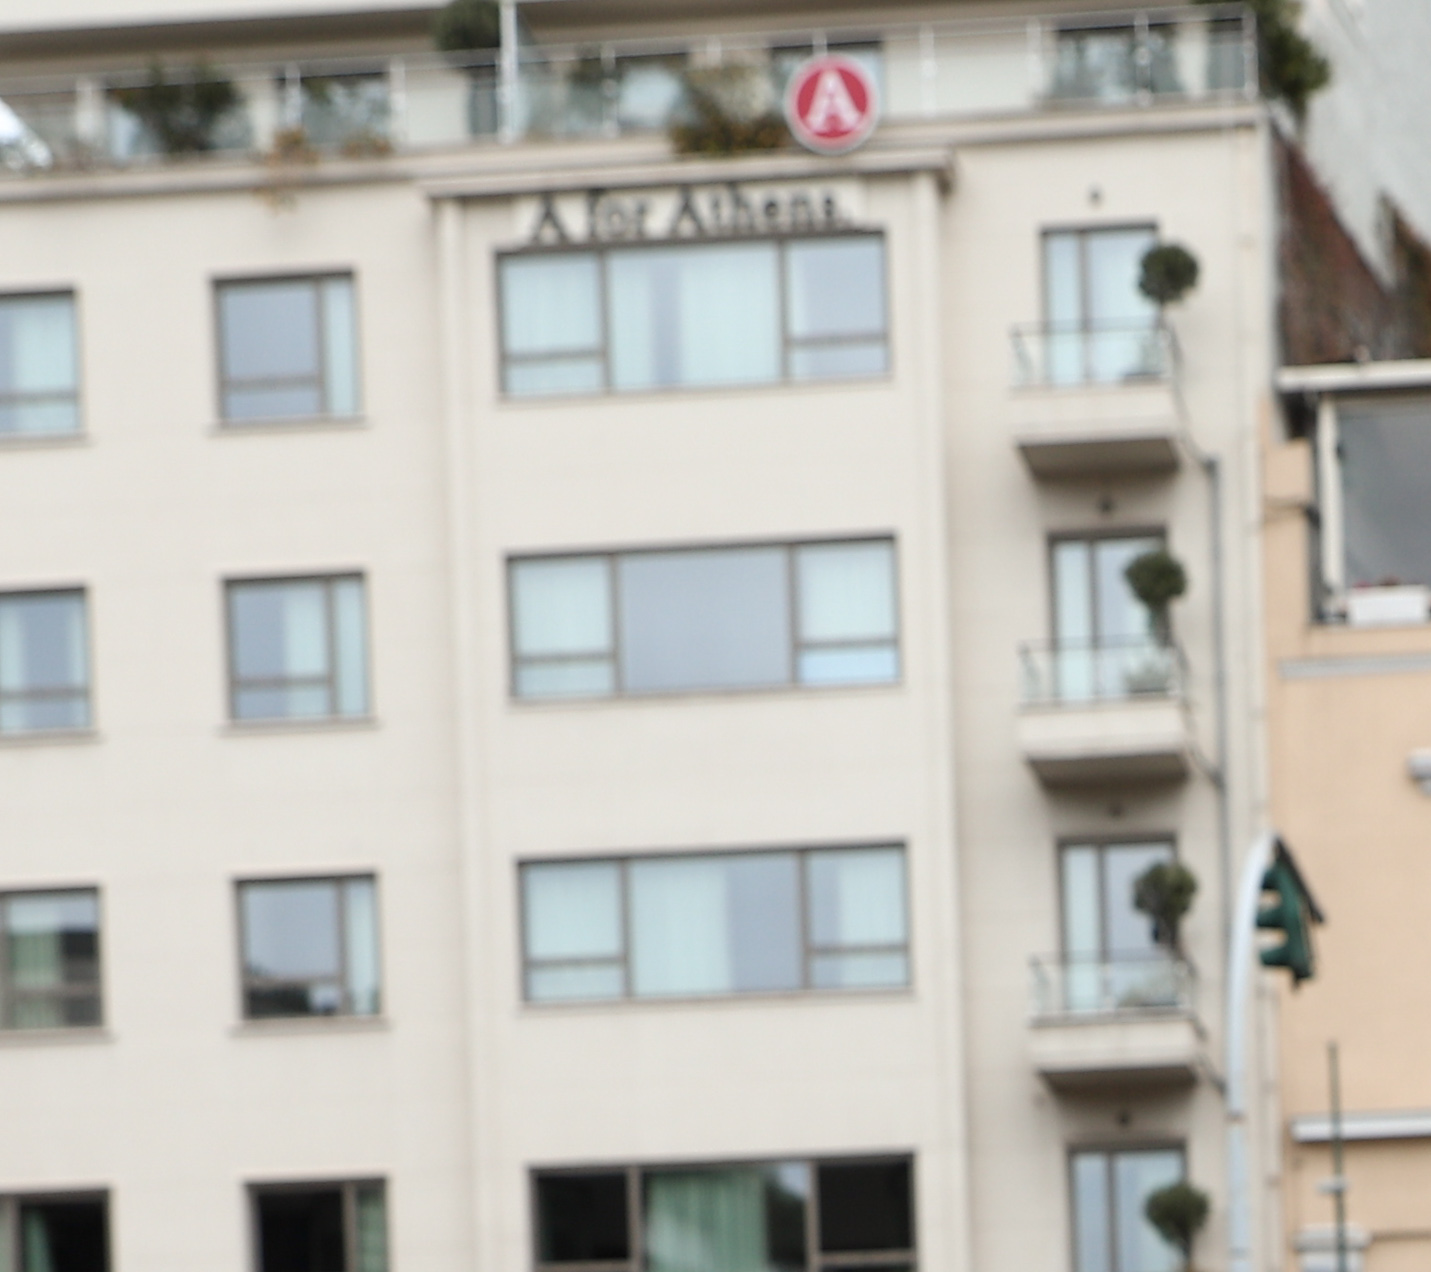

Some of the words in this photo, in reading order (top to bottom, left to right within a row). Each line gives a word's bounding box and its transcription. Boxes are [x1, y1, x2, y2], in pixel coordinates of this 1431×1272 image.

[805, 69, 864, 133] A
[531, 190, 568, 245] A
[586, 186, 648, 242] for
[669, 181, 836, 238] Athens
